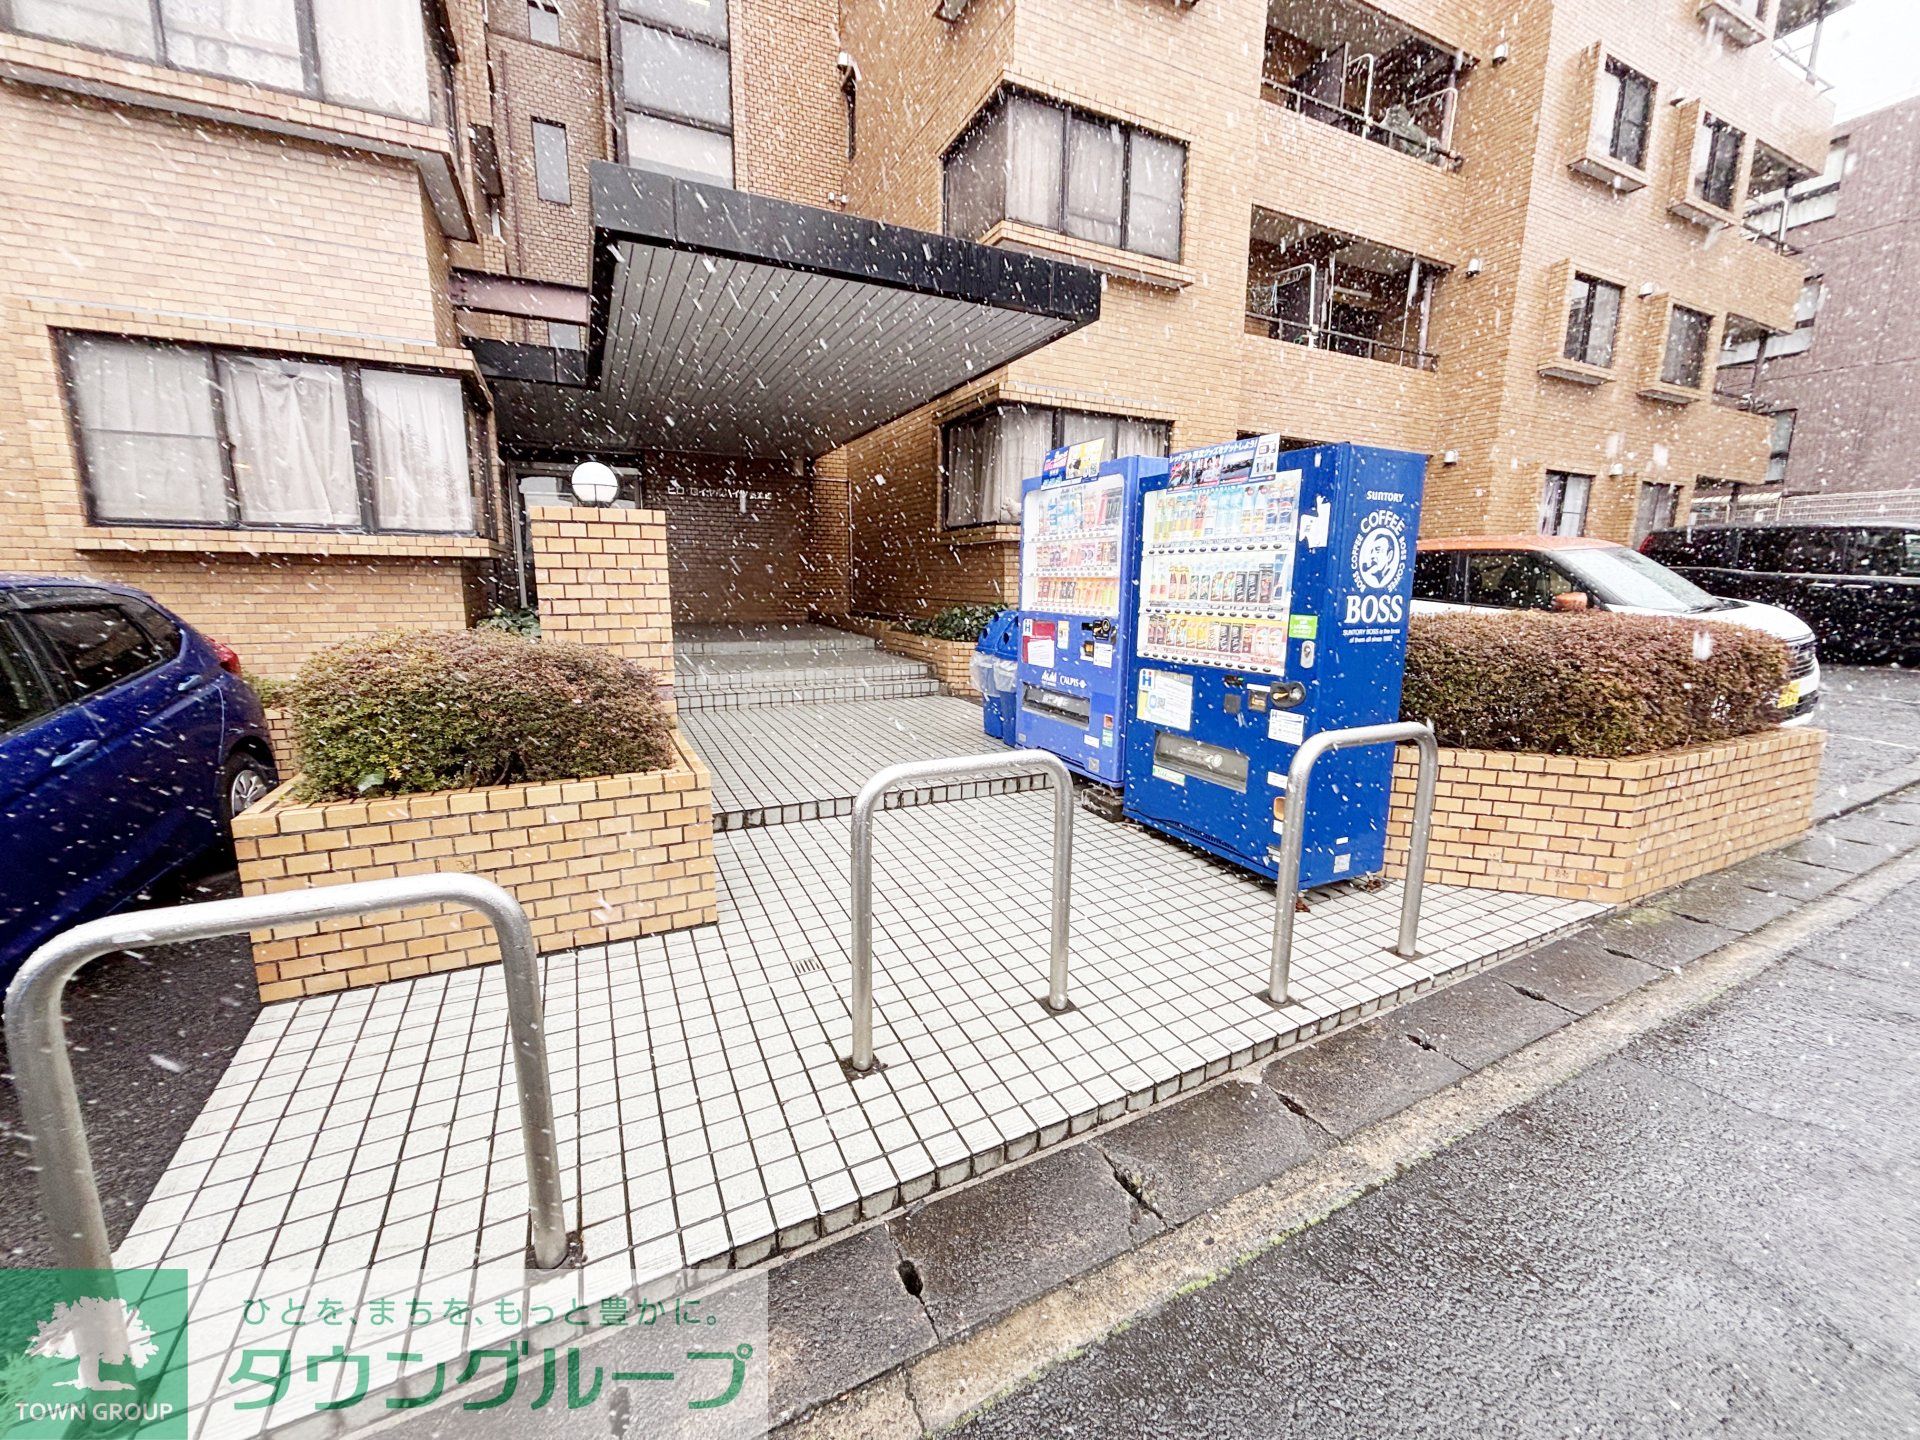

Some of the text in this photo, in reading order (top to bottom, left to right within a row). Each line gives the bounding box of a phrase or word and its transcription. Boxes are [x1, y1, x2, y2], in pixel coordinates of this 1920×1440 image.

[1366, 490, 1404, 503] SUNTORY
[1360, 509, 1406, 536] COFFEE
[1343, 594, 1404, 624] BOSS
